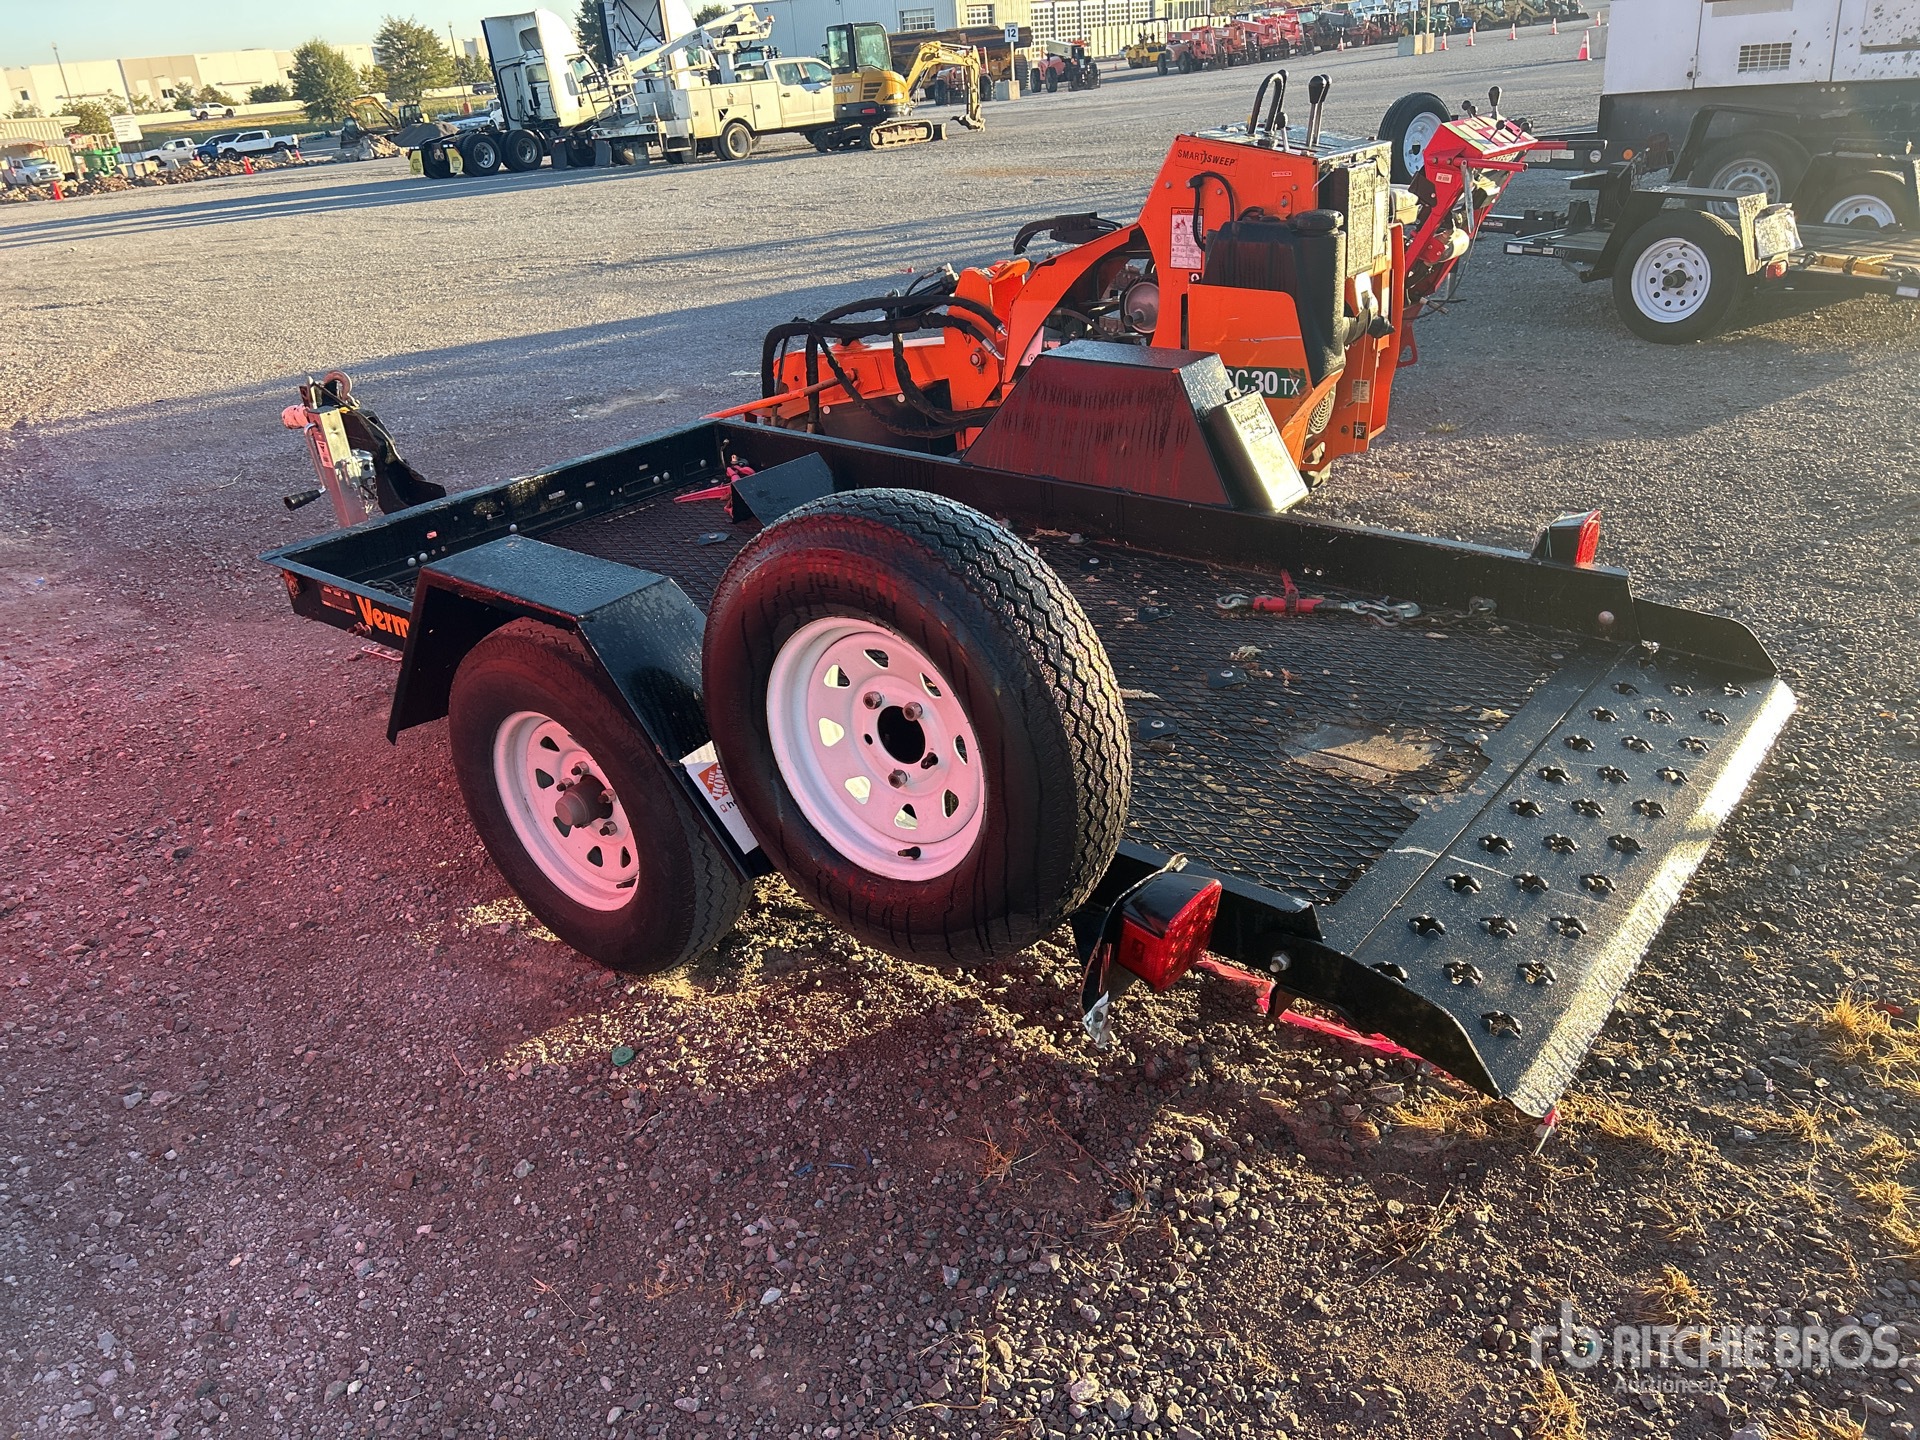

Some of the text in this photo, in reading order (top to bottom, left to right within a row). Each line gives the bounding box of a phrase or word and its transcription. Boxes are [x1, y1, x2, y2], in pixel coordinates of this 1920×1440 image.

[1007, 28, 1016, 38] 12
[1177, 149, 1237, 167] SMART SWEEP
[1280, 377, 1300, 396] TX
[356, 595, 410, 638] Verm
